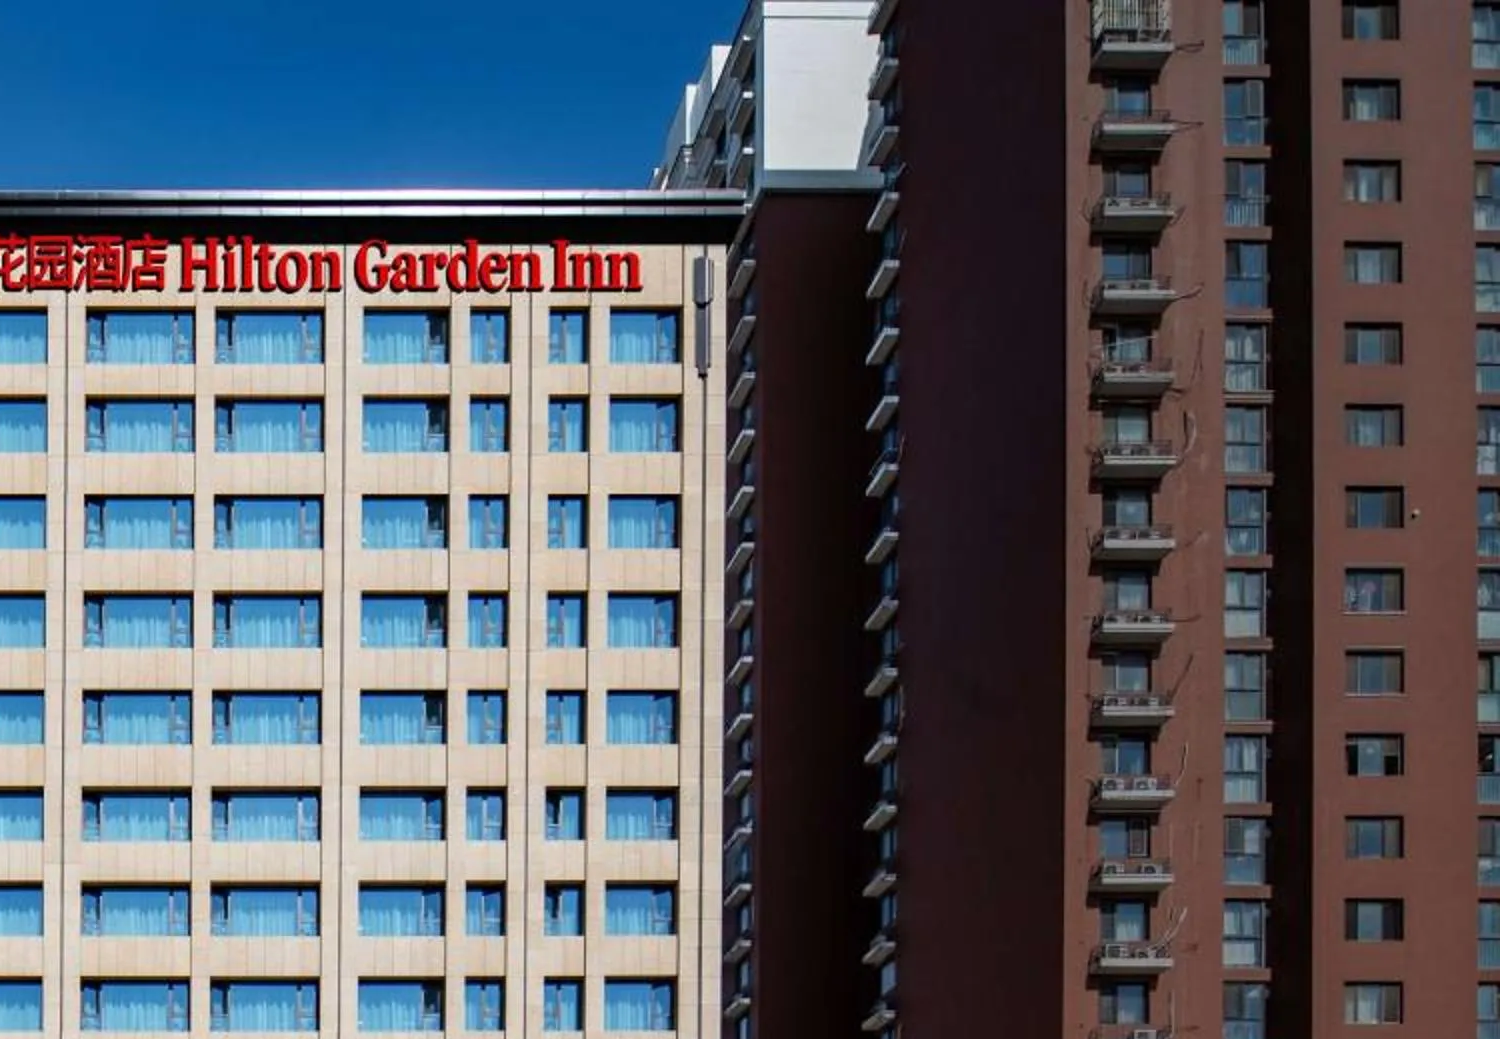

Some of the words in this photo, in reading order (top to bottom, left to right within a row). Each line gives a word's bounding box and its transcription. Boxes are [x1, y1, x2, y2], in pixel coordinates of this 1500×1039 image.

[179, 236, 342, 292] Hilton
[354, 239, 543, 293] Garden
[550, 239, 642, 292] Inn
